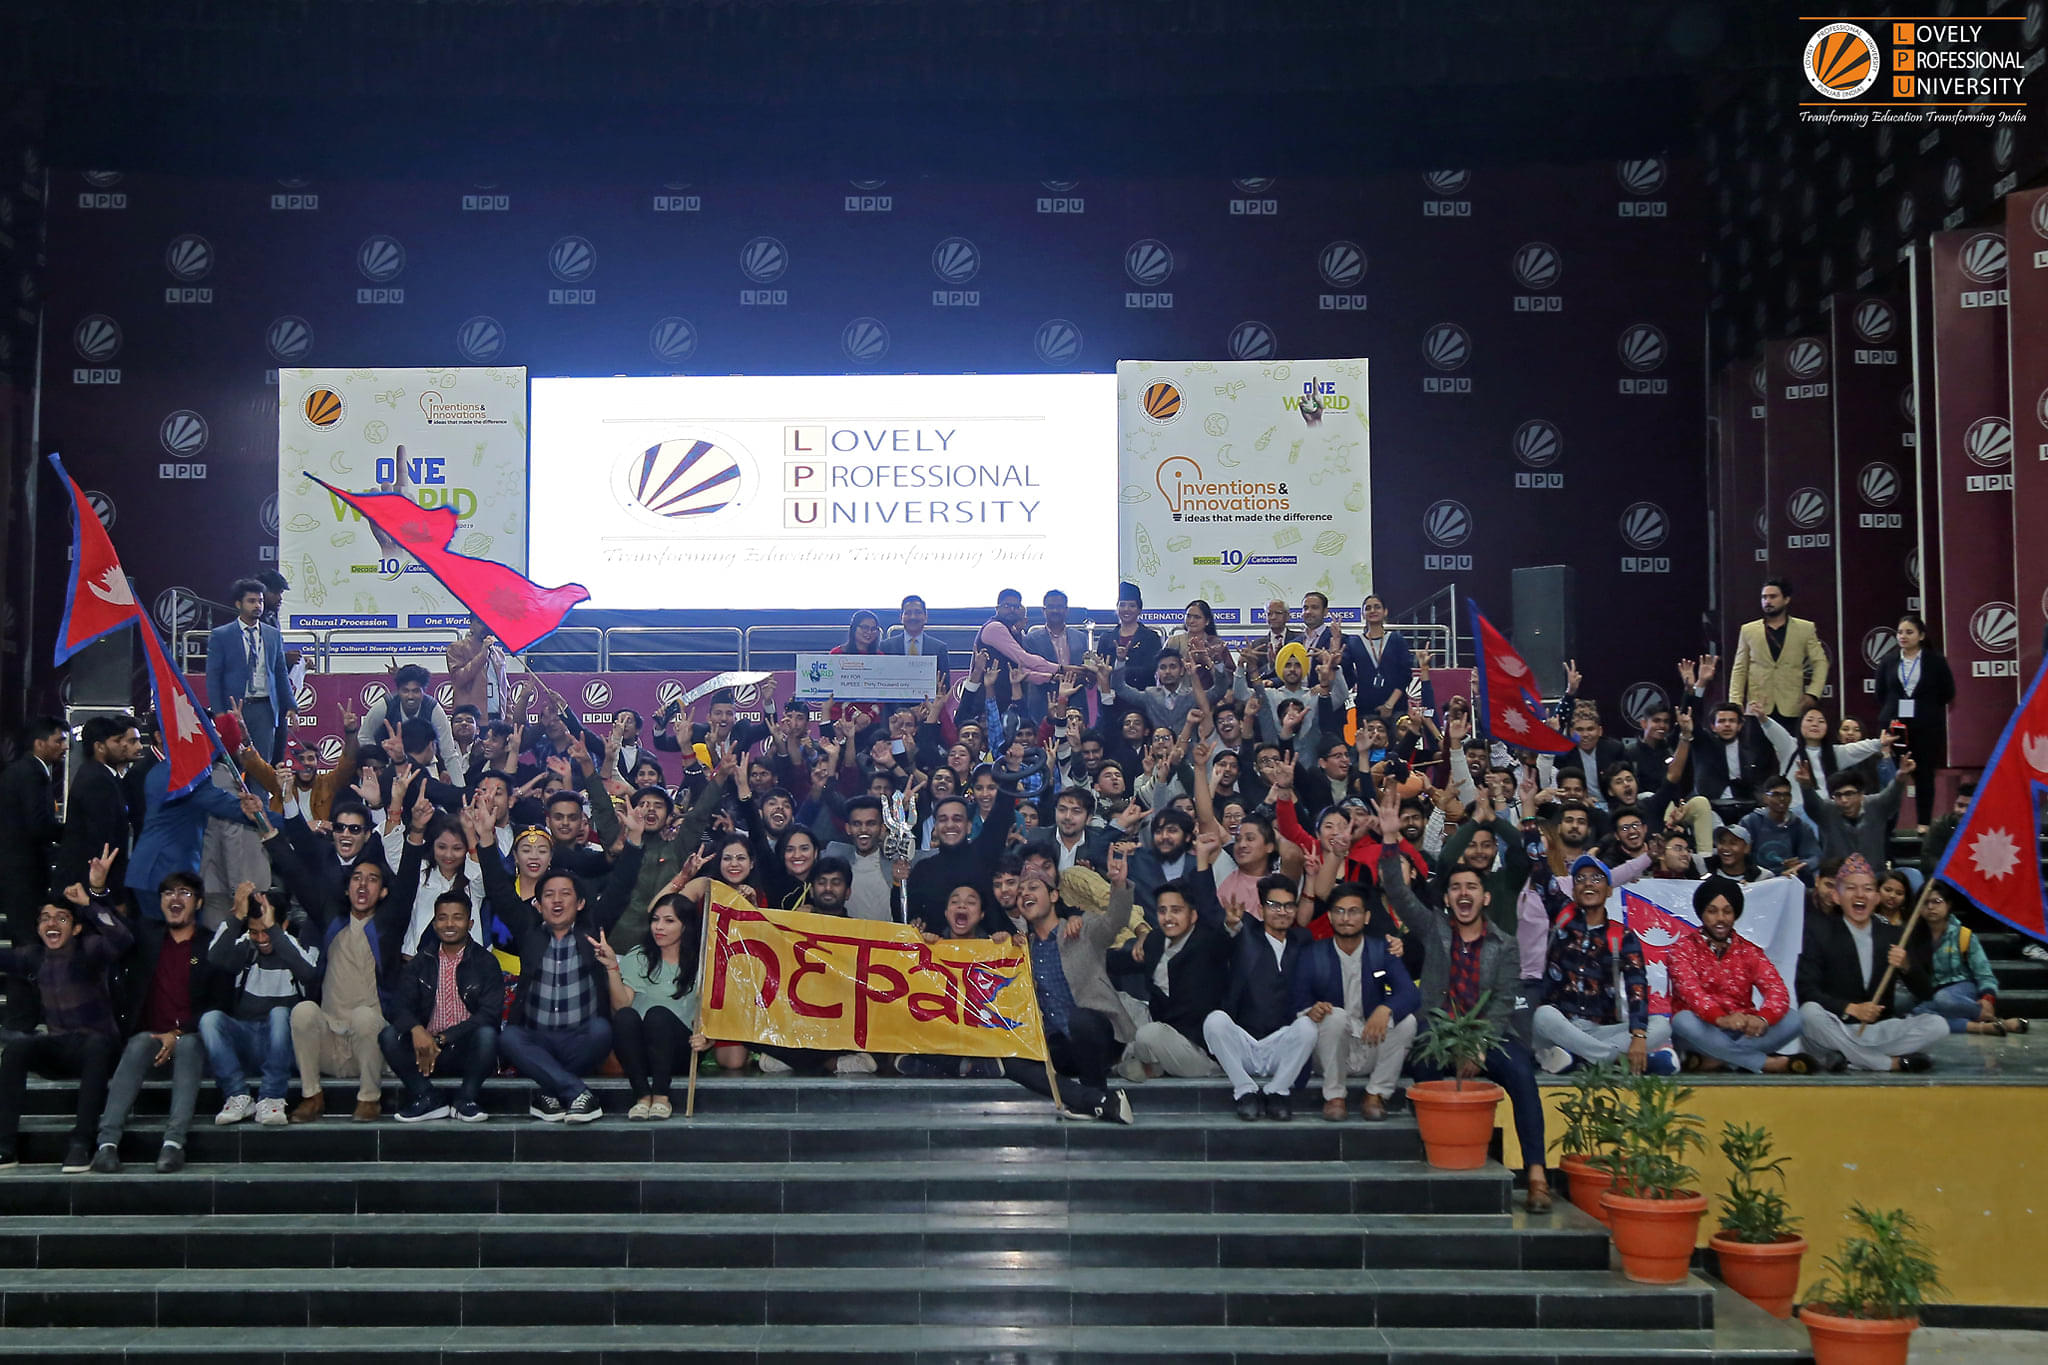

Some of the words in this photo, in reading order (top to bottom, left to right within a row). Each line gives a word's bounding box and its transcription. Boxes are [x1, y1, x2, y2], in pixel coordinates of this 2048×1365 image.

[82, 195, 125, 207] LPU
[274, 196, 317, 208] LPU
[465, 197, 508, 209] LPU
[656, 197, 699, 209] LPU
[848, 197, 891, 209] LPU
[1040, 199, 1083, 211] LPU
[1233, 201, 1276, 213] LPU
[1426, 202, 1469, 214] LPU
[1622, 203, 1665, 215] LPU
[168, 289, 211, 301] LPU
[360, 290, 403, 302] LPU
[551, 291, 594, 303] LPU
[743, 291, 786, 303] LPU
[935, 292, 978, 304] LPU
[1128, 294, 1171, 306] LPU
[1322, 296, 1365, 308] LPU
[1517, 298, 1560, 310] LPU
[1856, 351, 1896, 363] LPU
[76, 370, 119, 382] LPU
[1426, 379, 1470, 391] LPU
[1622, 380, 1666, 392] LPU
[1787, 386, 1827, 398] LPU
[1282, 395, 1350, 410] WRLD
[794, 429, 957, 452] LOVELY
[162, 465, 205, 477] LPU
[375, 457, 446, 485] ONE
[794, 464, 1041, 488] PROFESSIONAL
[1517, 475, 1562, 487] LPU
[794, 501, 1041, 524] UNIVERSITY
[1184, 514, 1211, 522] ideas
[1212, 514, 1232, 522] that
[1235, 514, 1263, 522] made
[1265, 513, 1281, 521] the
[1283, 513, 1332, 521] difference
[1861, 515, 1901, 527] LPU
[1790, 536, 1829, 547] LPU
[1221, 549, 1243, 565] 10
[1426, 557, 1471, 569] LPU
[378, 558, 400, 574] 10
[1623, 559, 1668, 571] LPU
[299, 618, 338, 626] Cultural
[339, 618, 388, 626] Procession
[424, 617, 443, 625] One
[369, 645, 398, 653] Diversity
[584, 714, 612, 723] LPU
